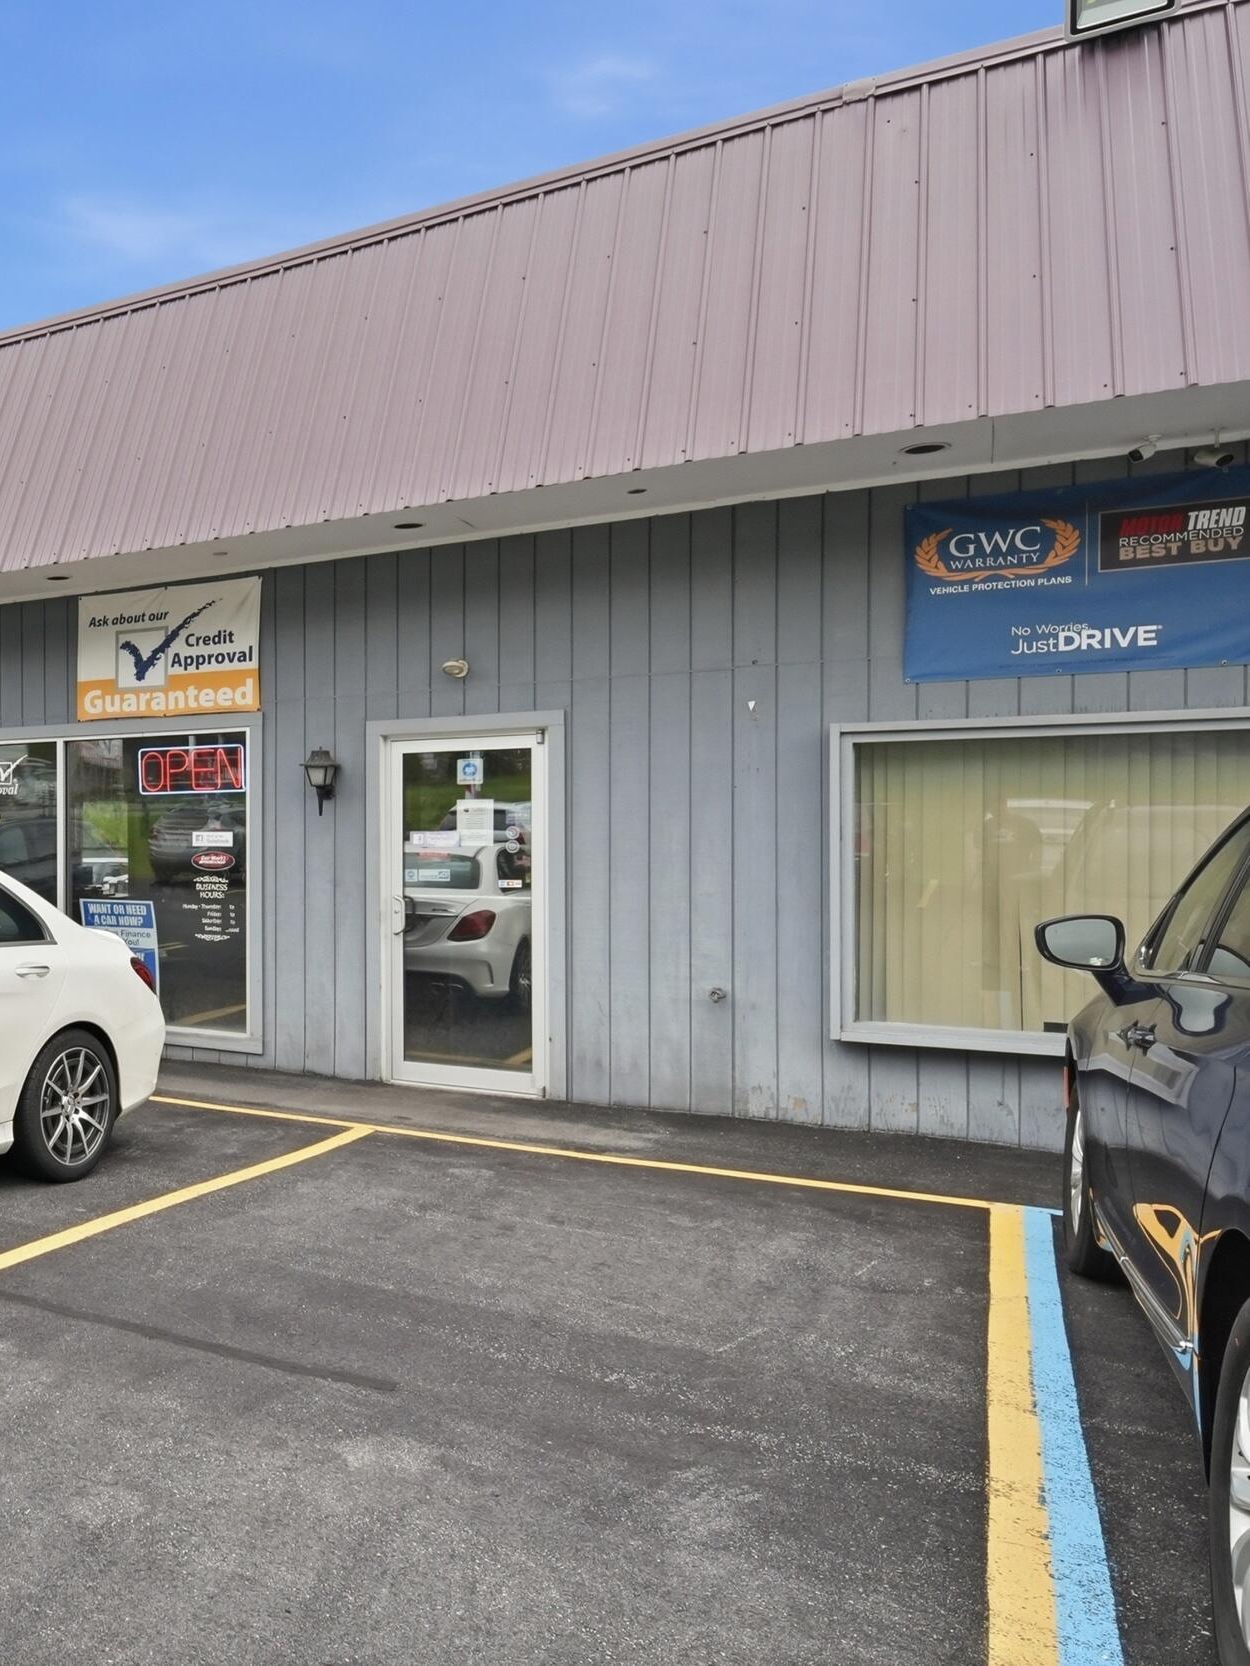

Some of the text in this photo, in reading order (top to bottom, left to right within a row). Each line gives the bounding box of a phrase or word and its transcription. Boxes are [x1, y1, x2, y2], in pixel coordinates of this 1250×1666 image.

[1187, 506, 1246, 531] TREND
[949, 526, 1041, 558] GWC
[1119, 526, 1244, 547] RECOMMENDED
[1119, 536, 1243, 560] BEST BUY
[950, 552, 1040, 570] WARRANTY
[929, 575, 1072, 595] VEHICLE PROTECTION PLANS
[88, 610, 169, 628] Ask about our
[185, 630, 234, 647] Credit
[1011, 625, 1031, 637] No
[170, 645, 253, 670] Approval
[84, 678, 254, 714] Guaranteed
[142, 747, 242, 792] OPEN
[195, 883, 228, 891] BUSINESS
[200, 891, 225, 899] HOURS:
[87, 903, 147, 915] WANT OR NEED
[94, 915, 144, 926] A CAR NOW?
[120, 929, 151, 938] Finance
